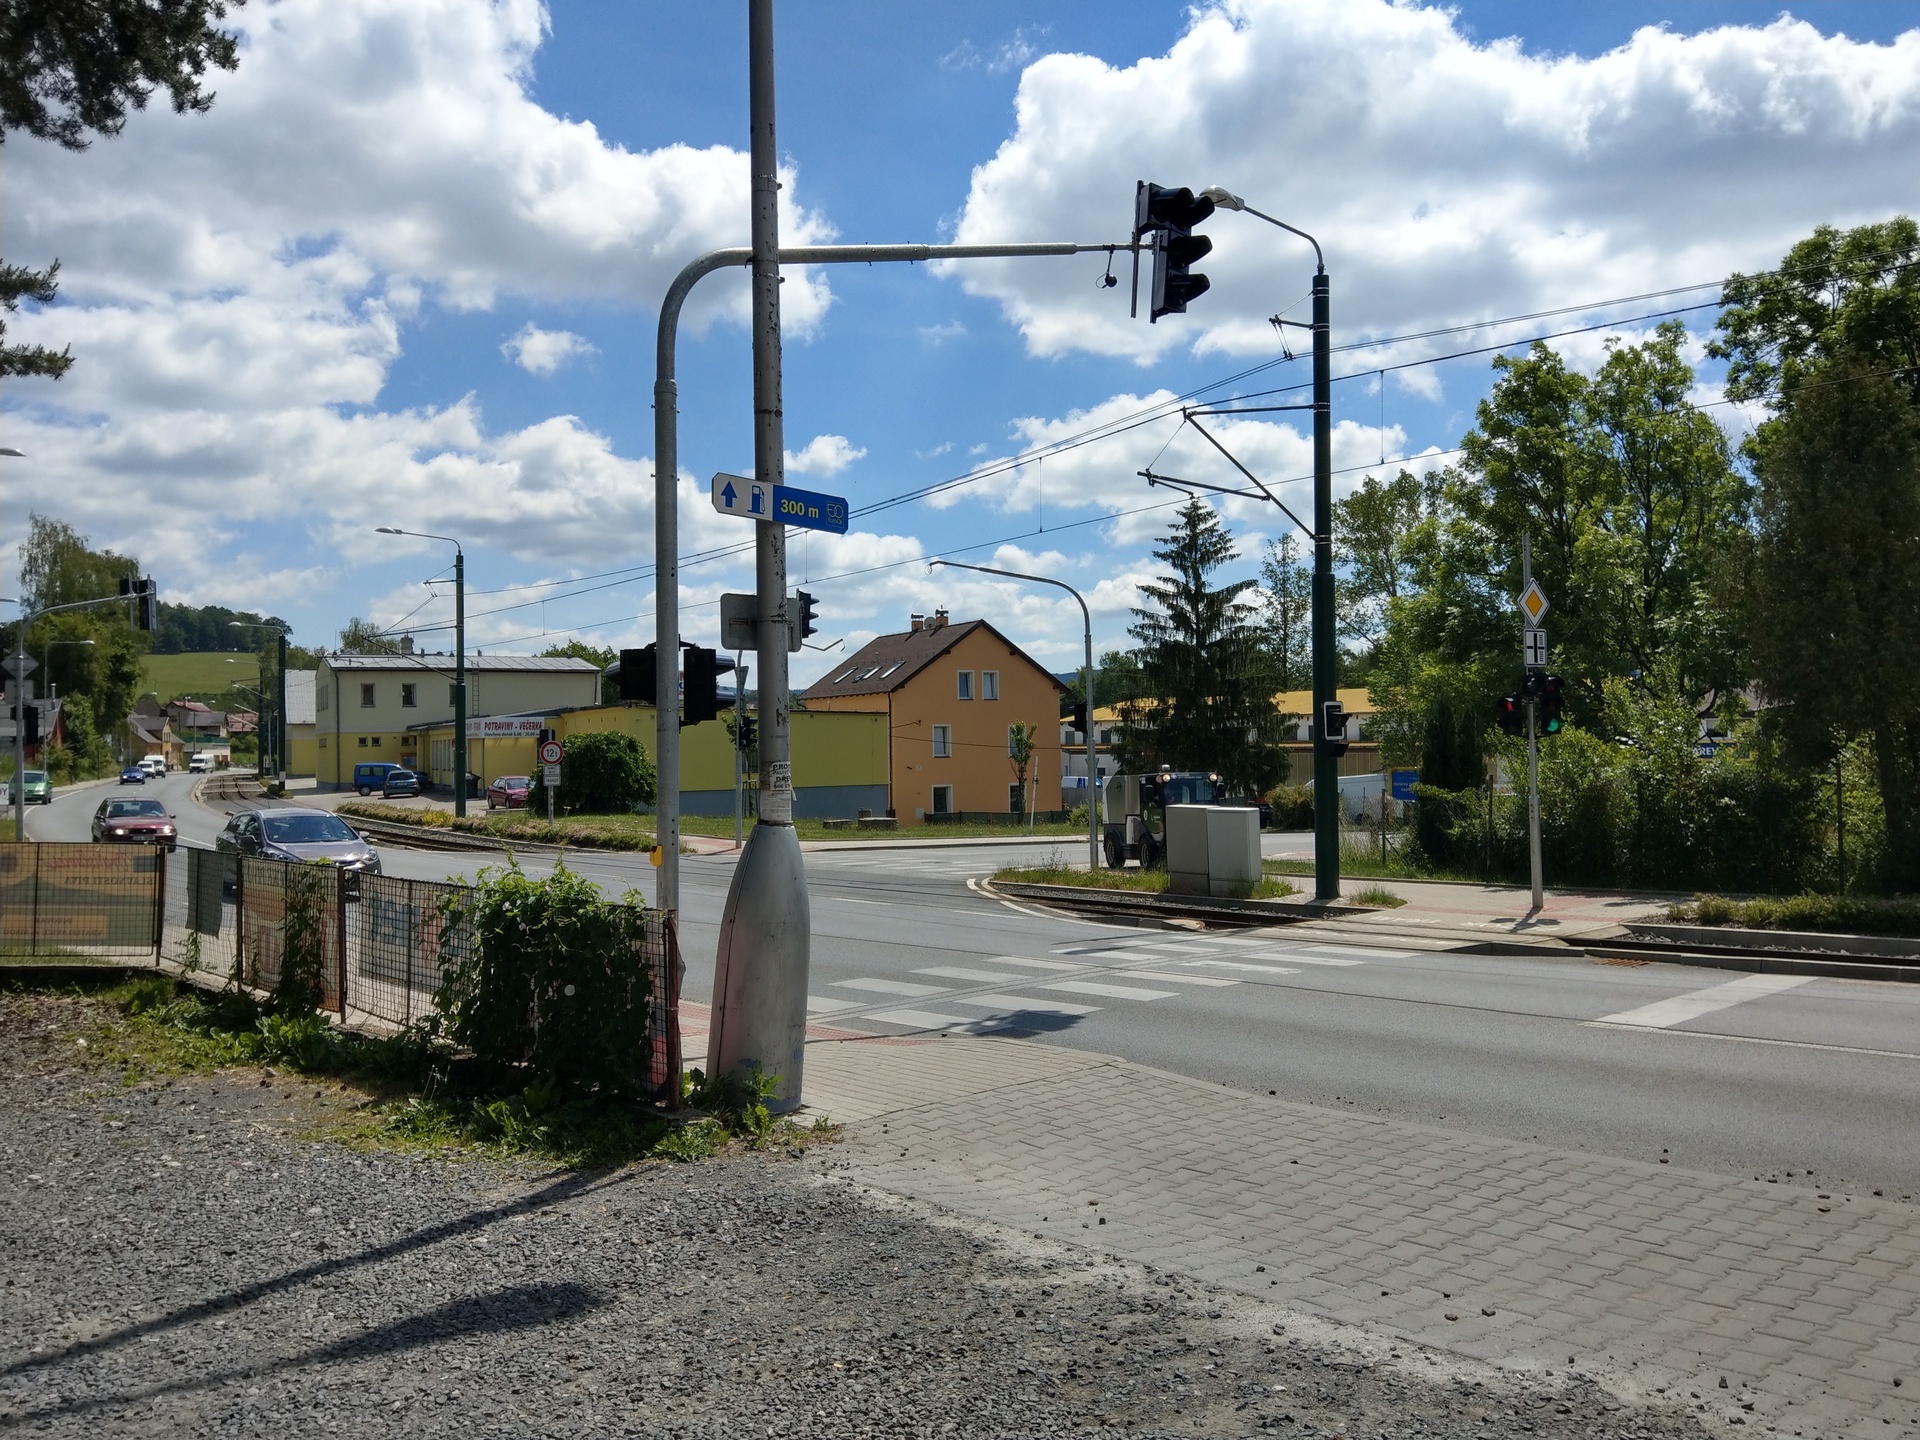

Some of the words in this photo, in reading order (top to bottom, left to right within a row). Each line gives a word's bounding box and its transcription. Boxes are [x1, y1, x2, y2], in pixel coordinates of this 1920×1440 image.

[780, 499, 805, 516] 300
[808, 506, 819, 519] m
[484, 722, 514, 730] POTRAVINY
[520, 720, 542, 730] VEČERKA
[546, 748, 554, 757] 12
